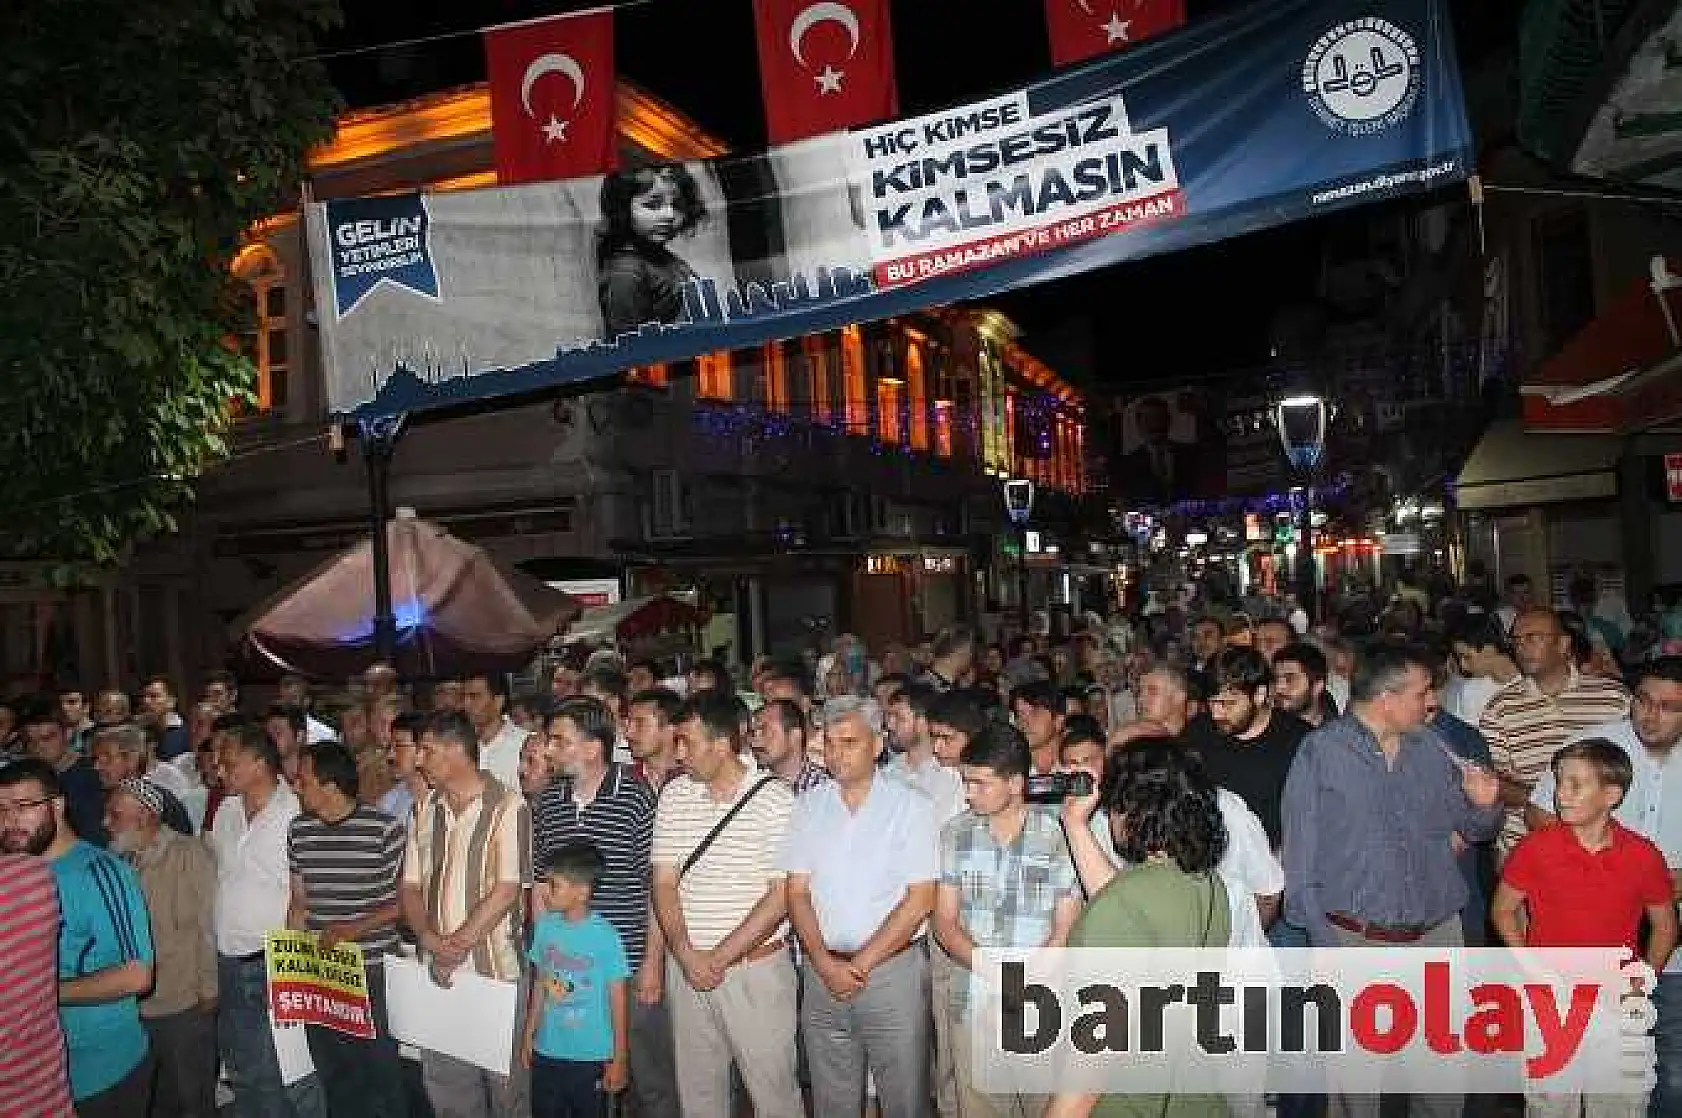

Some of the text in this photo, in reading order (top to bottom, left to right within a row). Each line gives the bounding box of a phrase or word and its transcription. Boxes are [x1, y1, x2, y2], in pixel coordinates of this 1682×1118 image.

[876, 142, 1164, 247] KALMASIN
[887, 261, 915, 281] BU
[918, 237, 1013, 275] RAMAZAN
[1055, 216, 1096, 239] HER
[1099, 196, 1174, 230] ZAMAN
